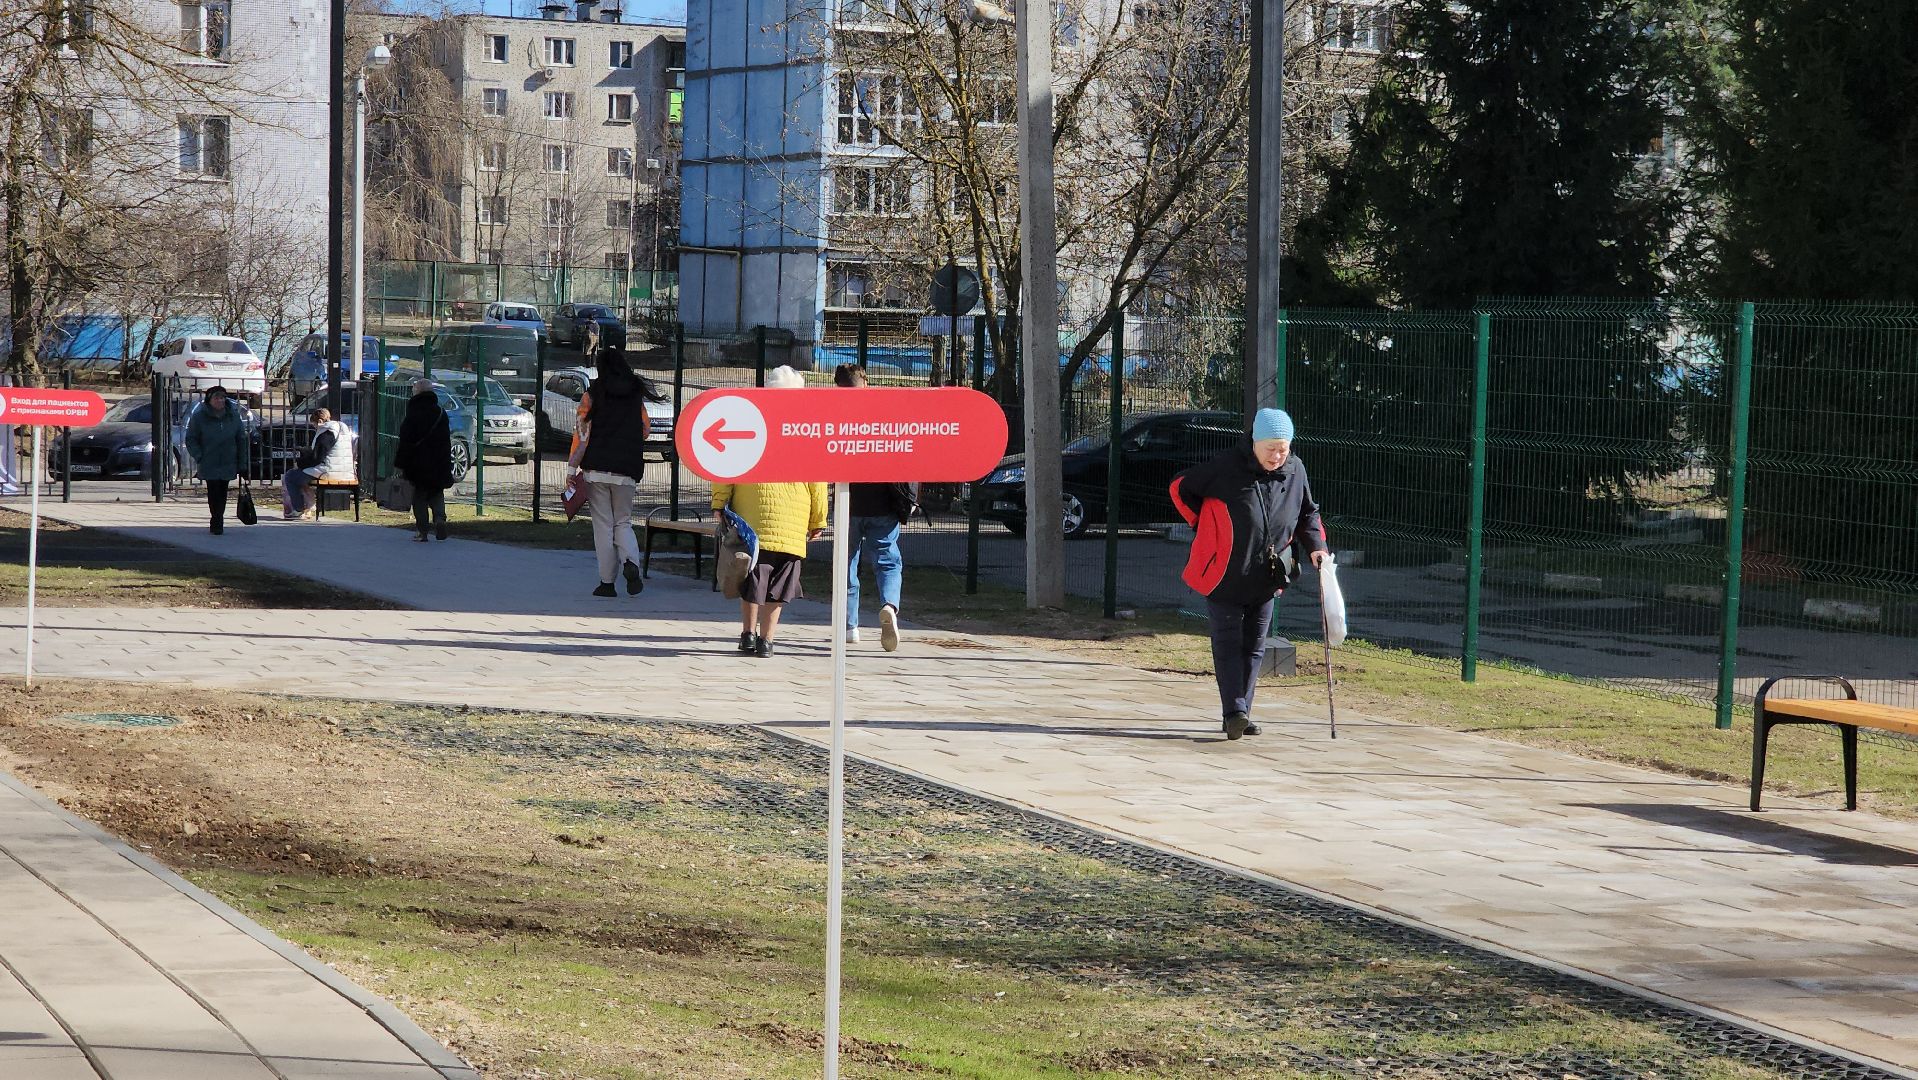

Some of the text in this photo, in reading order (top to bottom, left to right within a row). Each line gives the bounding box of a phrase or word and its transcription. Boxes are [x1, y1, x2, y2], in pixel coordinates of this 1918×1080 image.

[11, 397, 31, 406] Вход
[781, 422, 960, 438] ВХОД В ИНФЕКЦИОННОЕ
[826, 440, 914, 455] ОТДЕЛЕНИЕ
